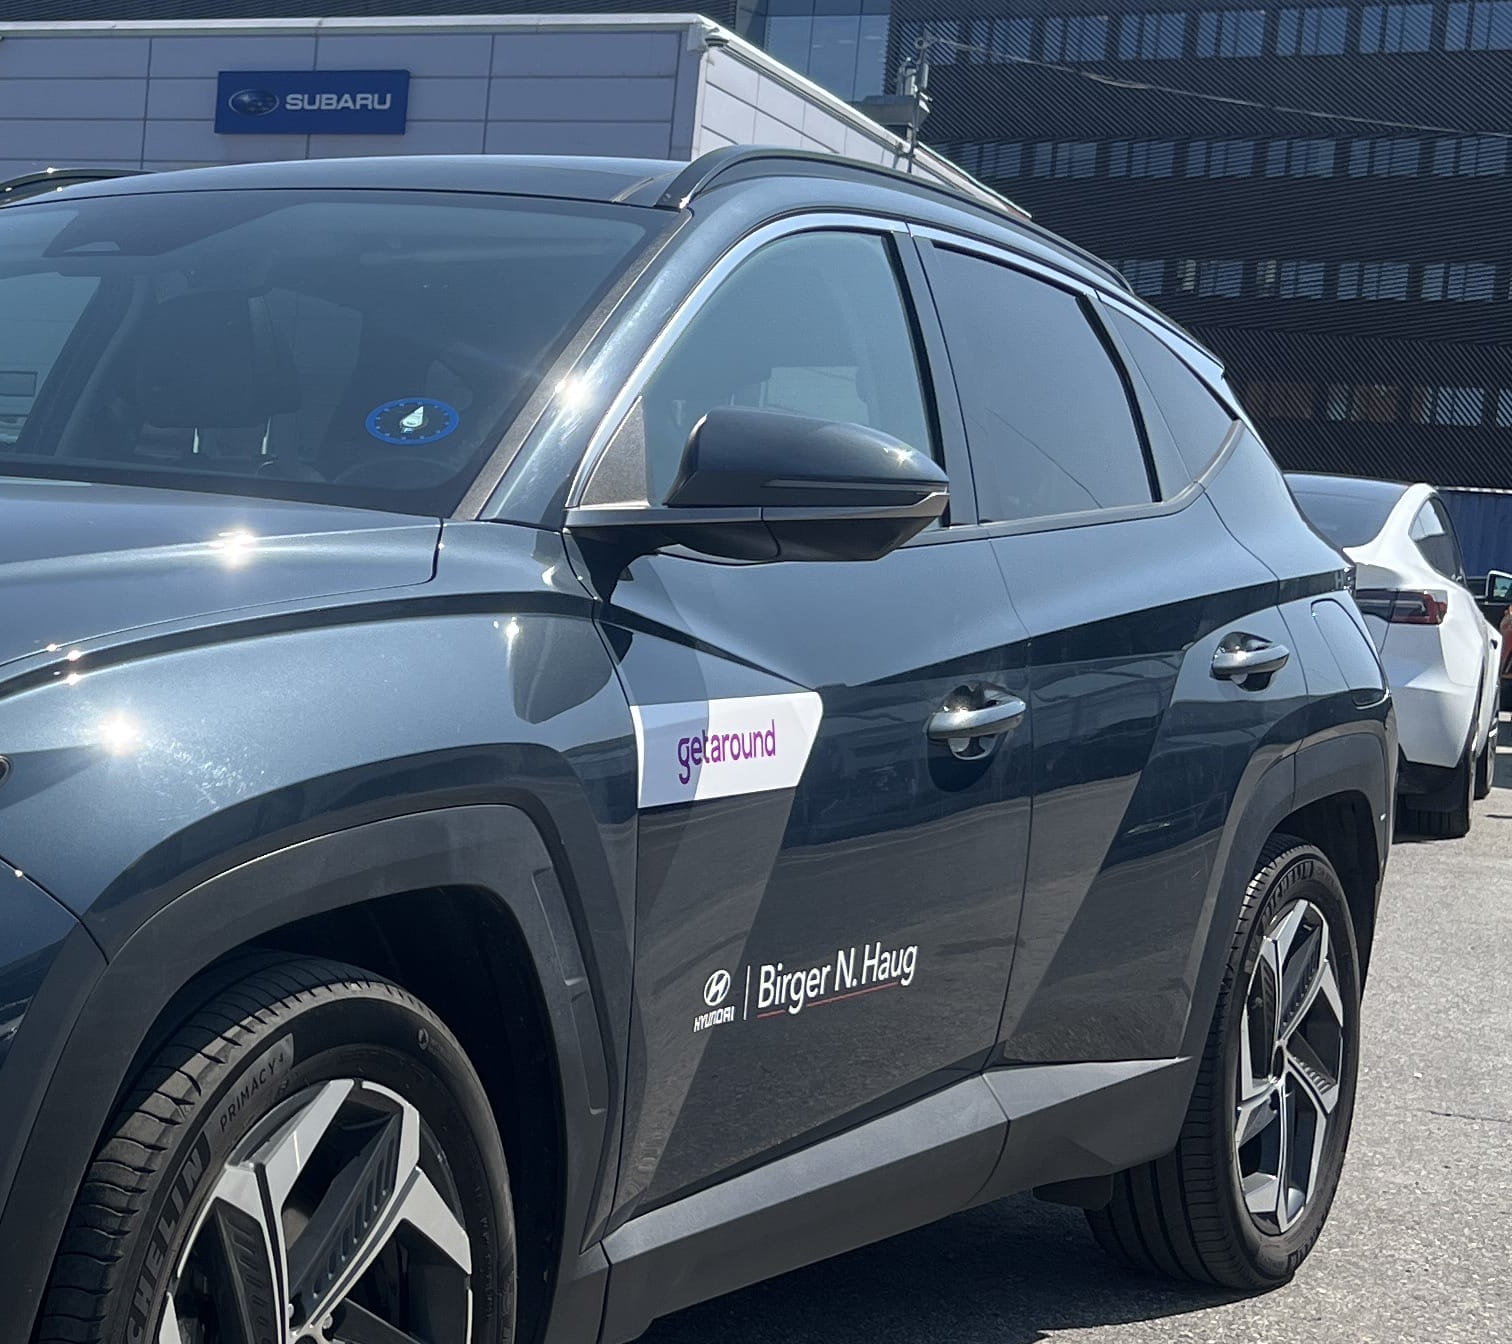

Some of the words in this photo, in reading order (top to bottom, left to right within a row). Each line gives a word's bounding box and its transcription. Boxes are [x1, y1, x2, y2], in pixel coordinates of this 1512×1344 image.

[285, 93, 392, 111] SUBARU
[677, 718, 777, 785] getaround
[757, 962, 832, 1015] Birger
[834, 946, 858, 992] N.
[861, 941, 919, 987] Haug
[693, 1005, 736, 1033] HYUNDAI
[219, 1058, 277, 1133] PRIMACY
